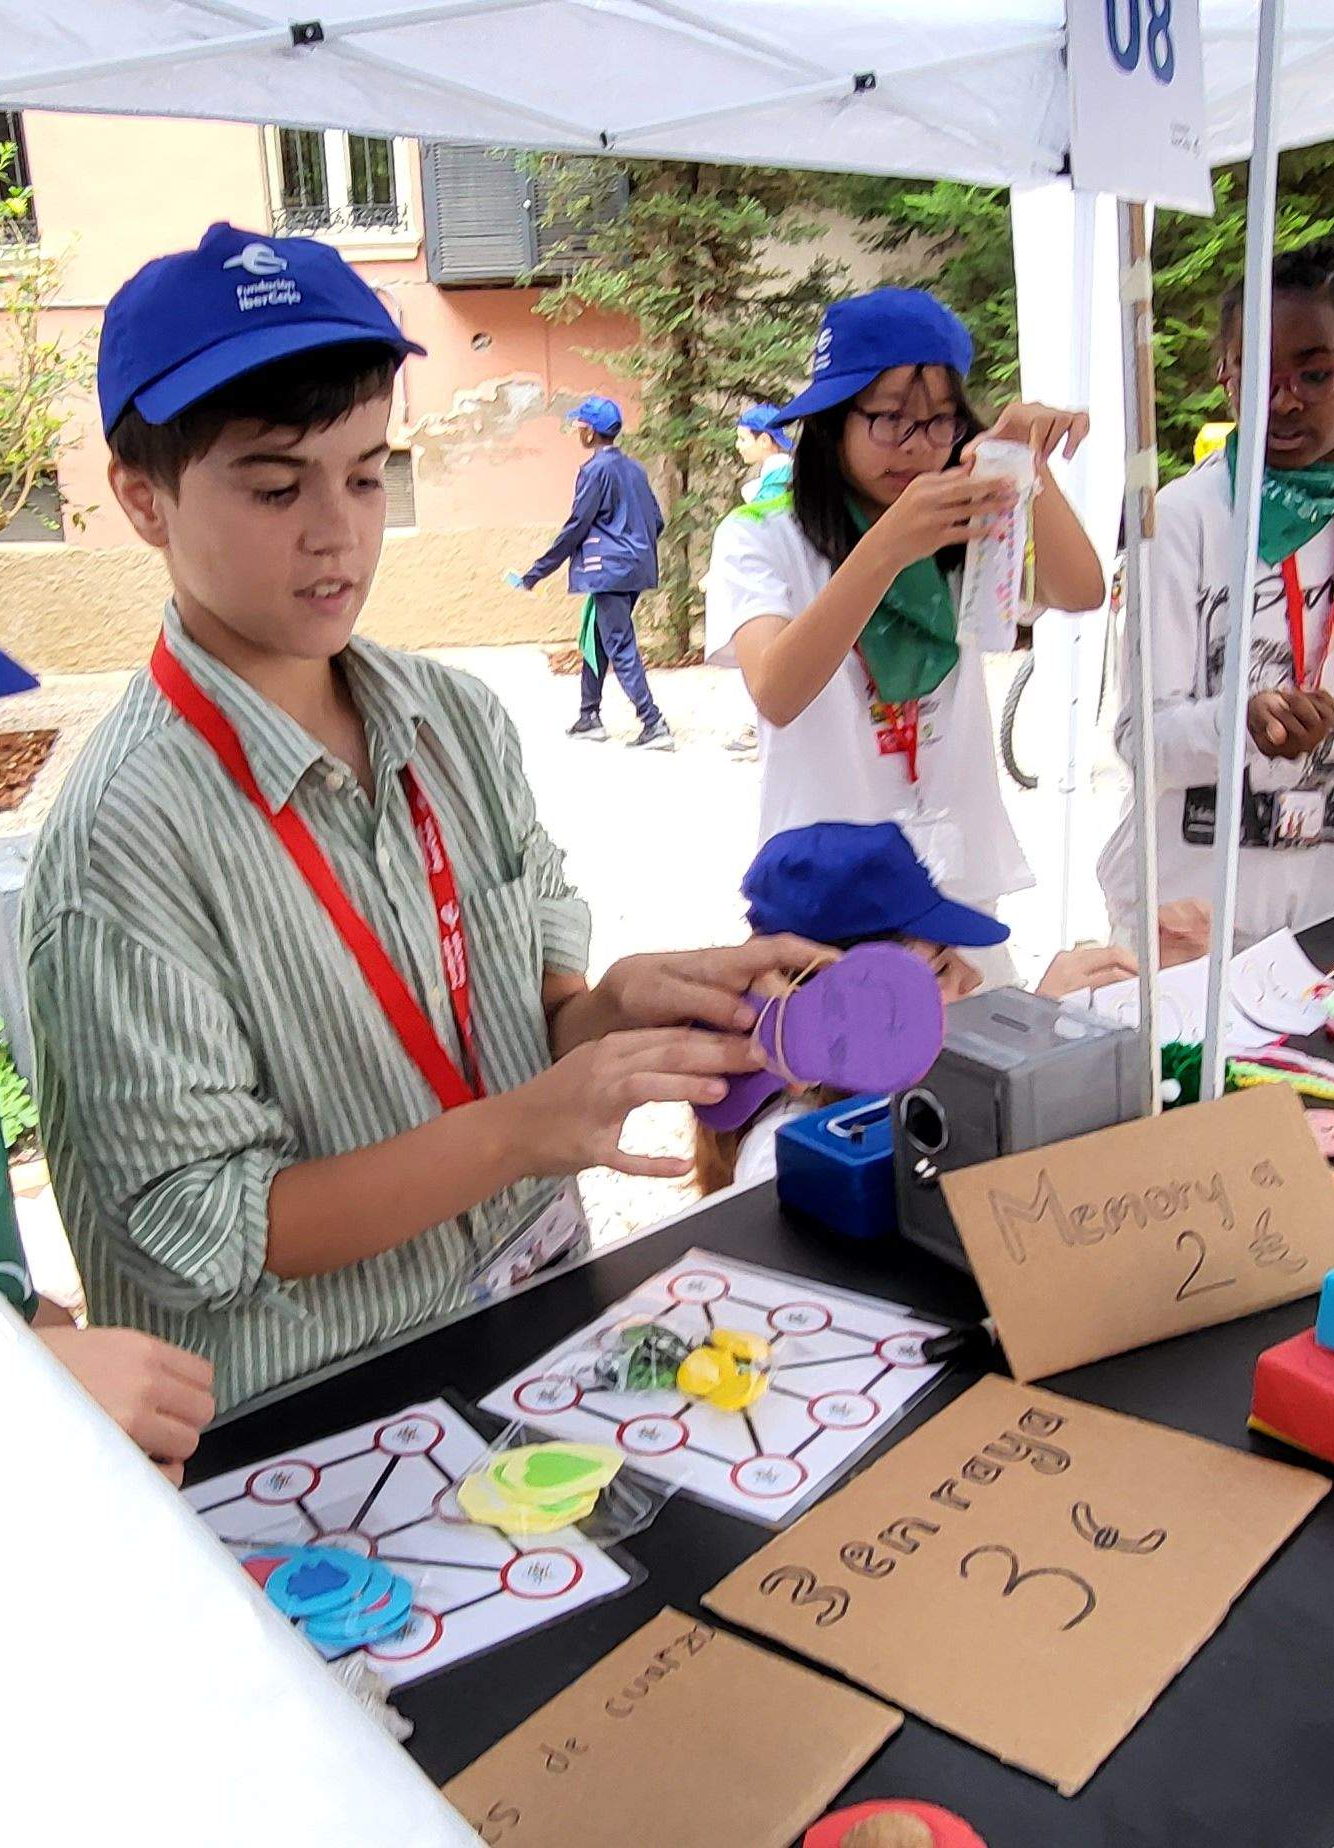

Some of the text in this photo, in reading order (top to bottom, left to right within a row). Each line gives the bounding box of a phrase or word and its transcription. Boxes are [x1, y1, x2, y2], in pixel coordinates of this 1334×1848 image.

[1105, 0, 1175, 86] 08
[988, 1168, 1235, 1266] Memory
[1175, 1230, 1237, 1302] 2
[760, 1406, 1072, 1628] 3 en raya
[960, 1544, 1098, 1632] 3
[538, 1735, 590, 1774] de
